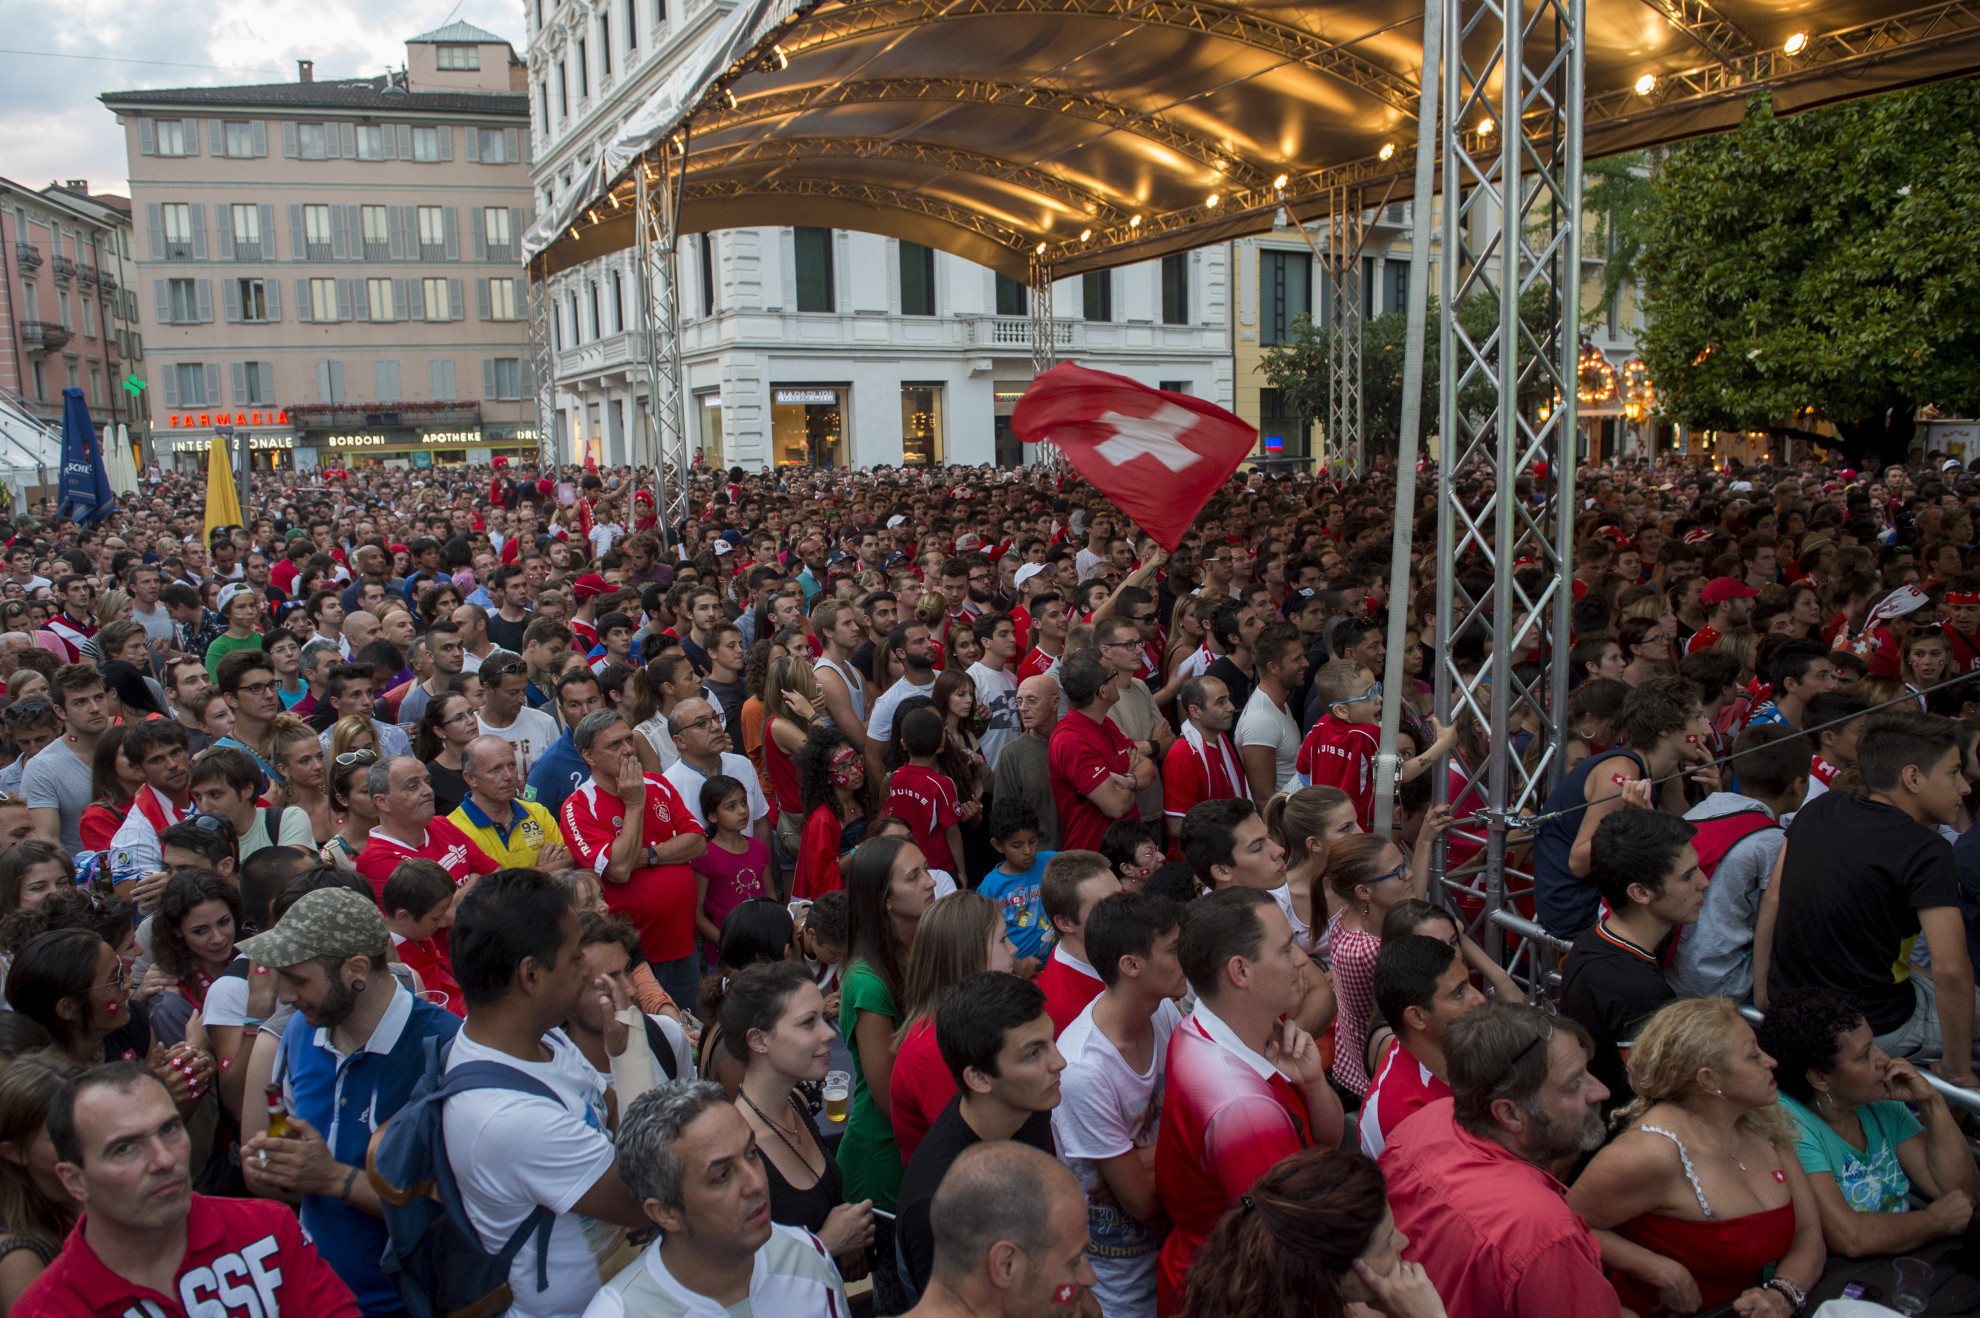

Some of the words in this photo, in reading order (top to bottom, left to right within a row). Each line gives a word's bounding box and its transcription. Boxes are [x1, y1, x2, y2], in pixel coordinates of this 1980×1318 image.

[170, 411, 288, 427] FARMACIA
[328, 435, 385, 446] BORDONI
[422, 432, 481, 443] APOTHEKE
[517, 430, 546, 440] DRU
[172, 437, 293, 452] INTERZONALE
[891, 788, 929, 806] SUISSE
[521, 820, 539, 833] 93
[1099, 1208, 1114, 1222] 20
[1098, 1222, 1112, 1235] 27
